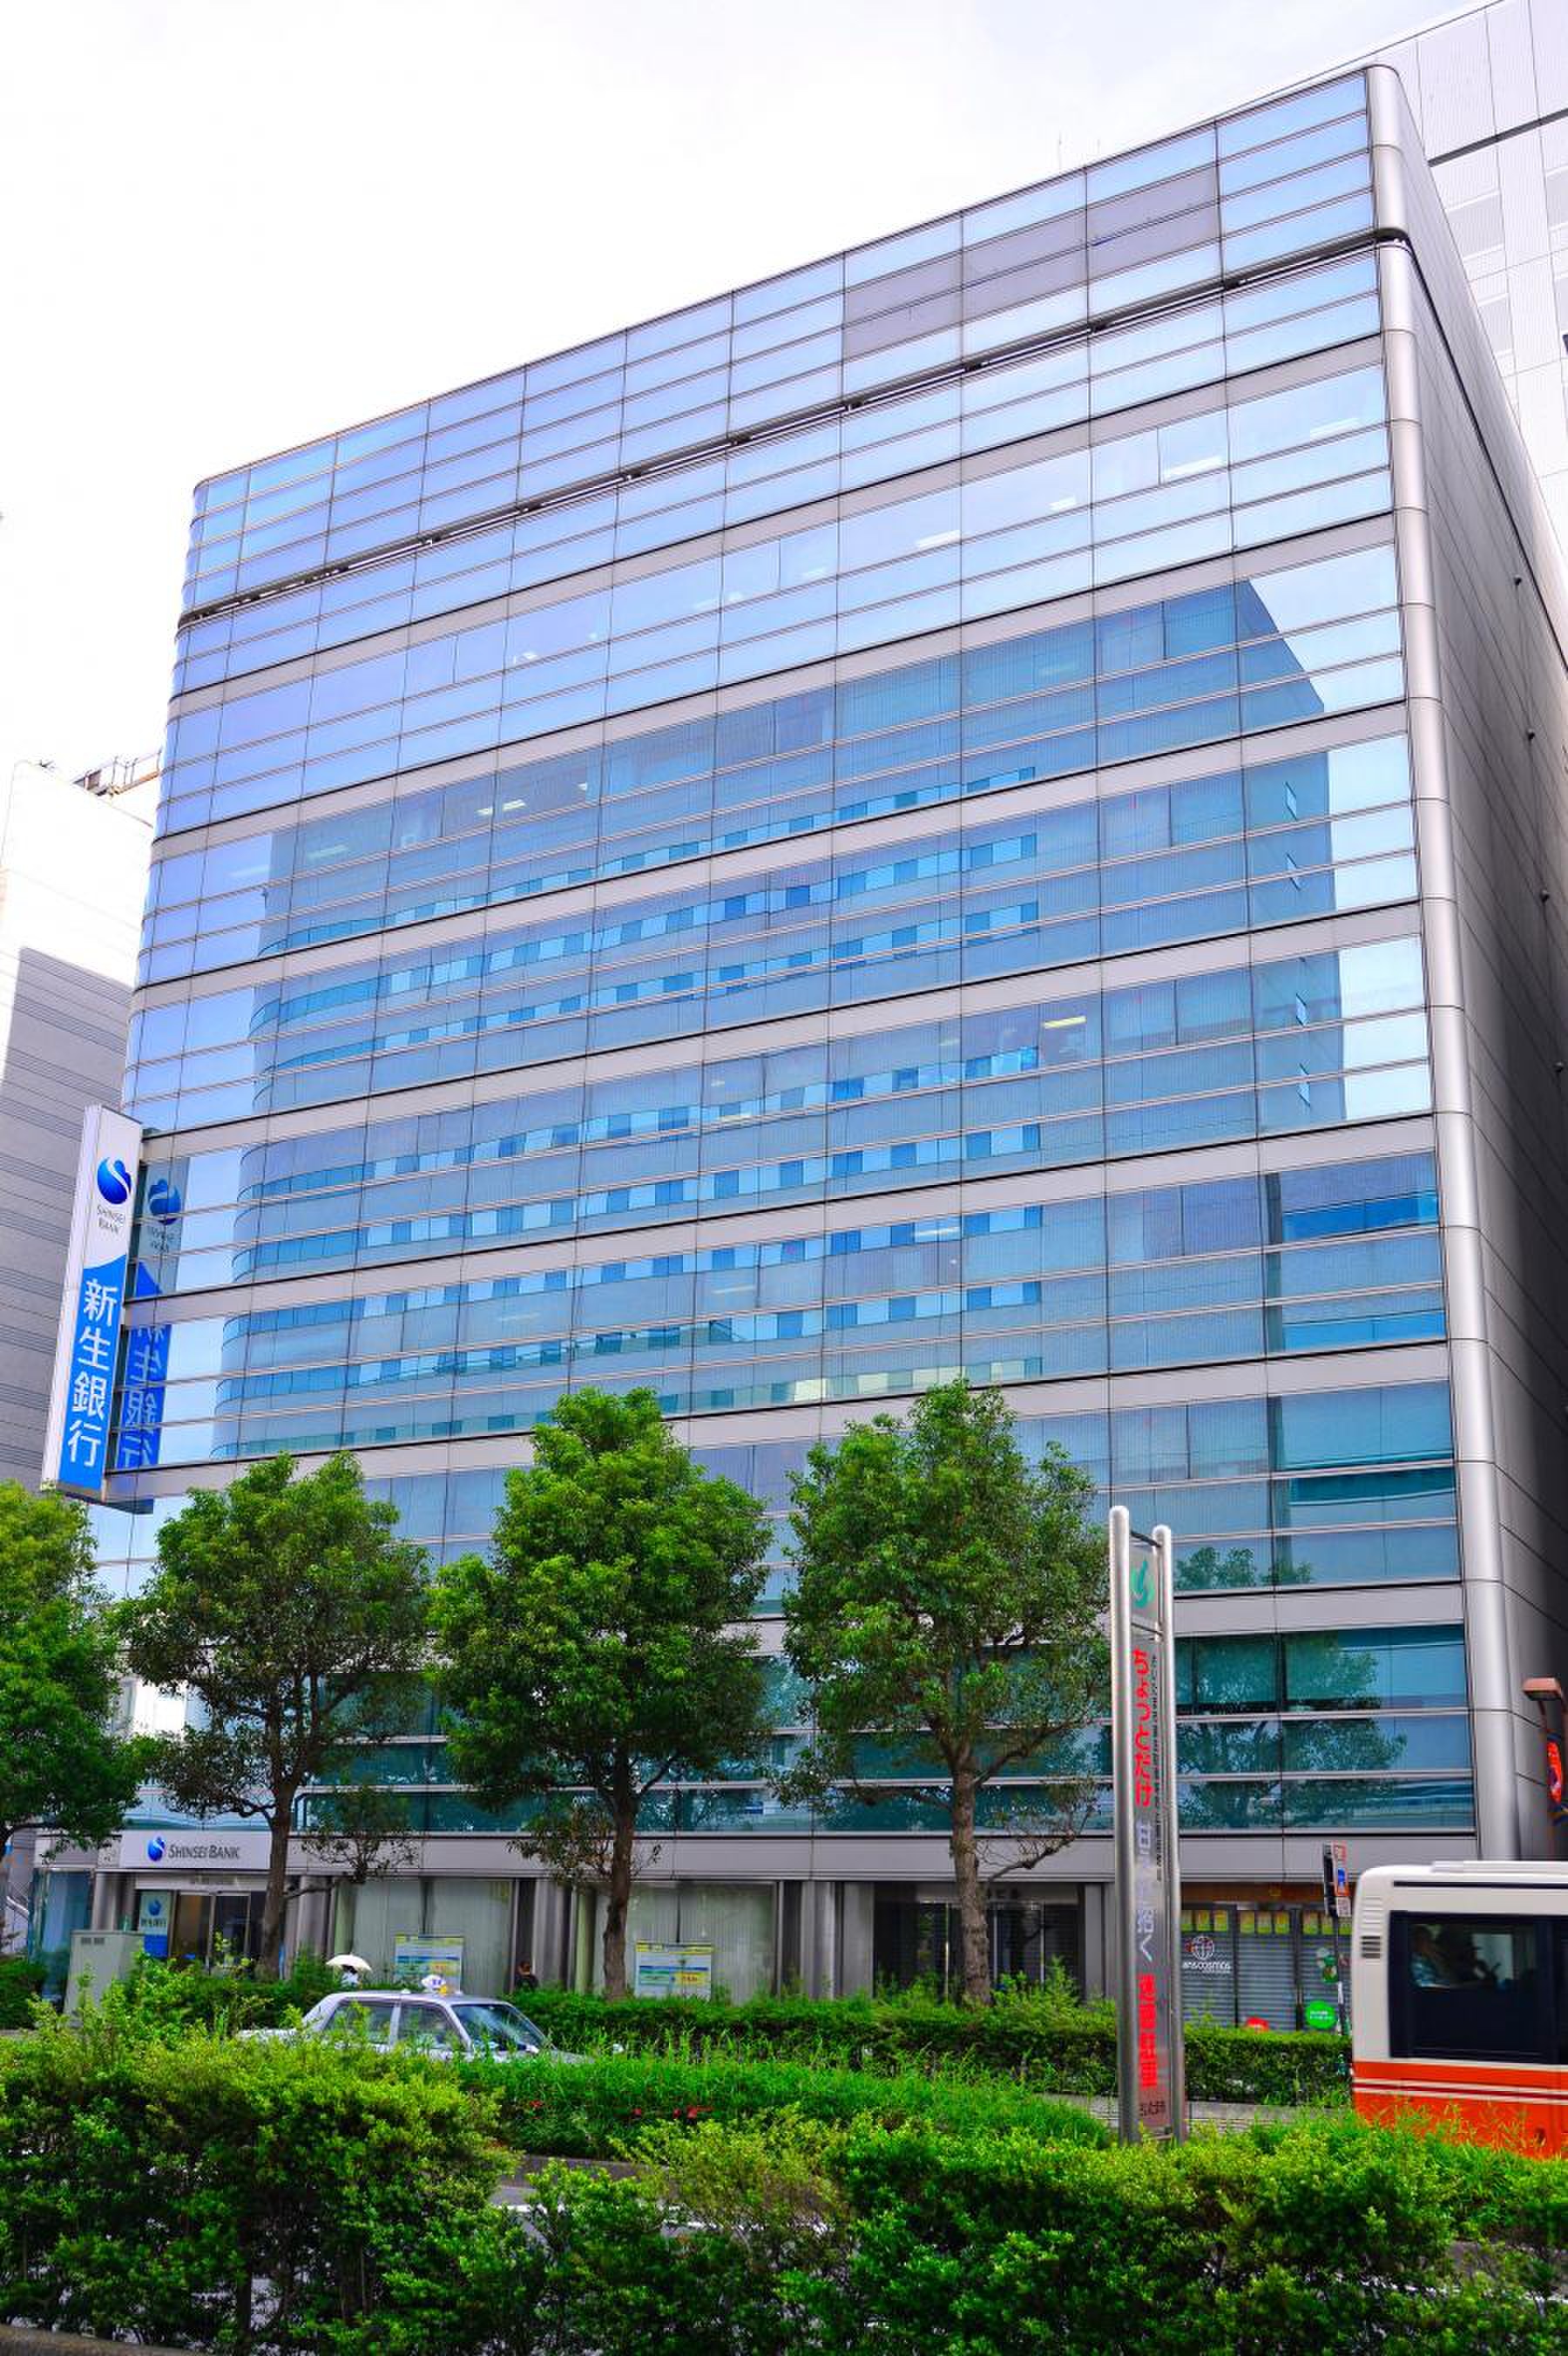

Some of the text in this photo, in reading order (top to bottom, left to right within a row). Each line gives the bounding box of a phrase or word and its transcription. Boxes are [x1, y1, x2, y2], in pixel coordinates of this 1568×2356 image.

[68, 1277, 118, 1468] 新生銀行
[168, 1844, 240, 1859] SHINSEI BANK
